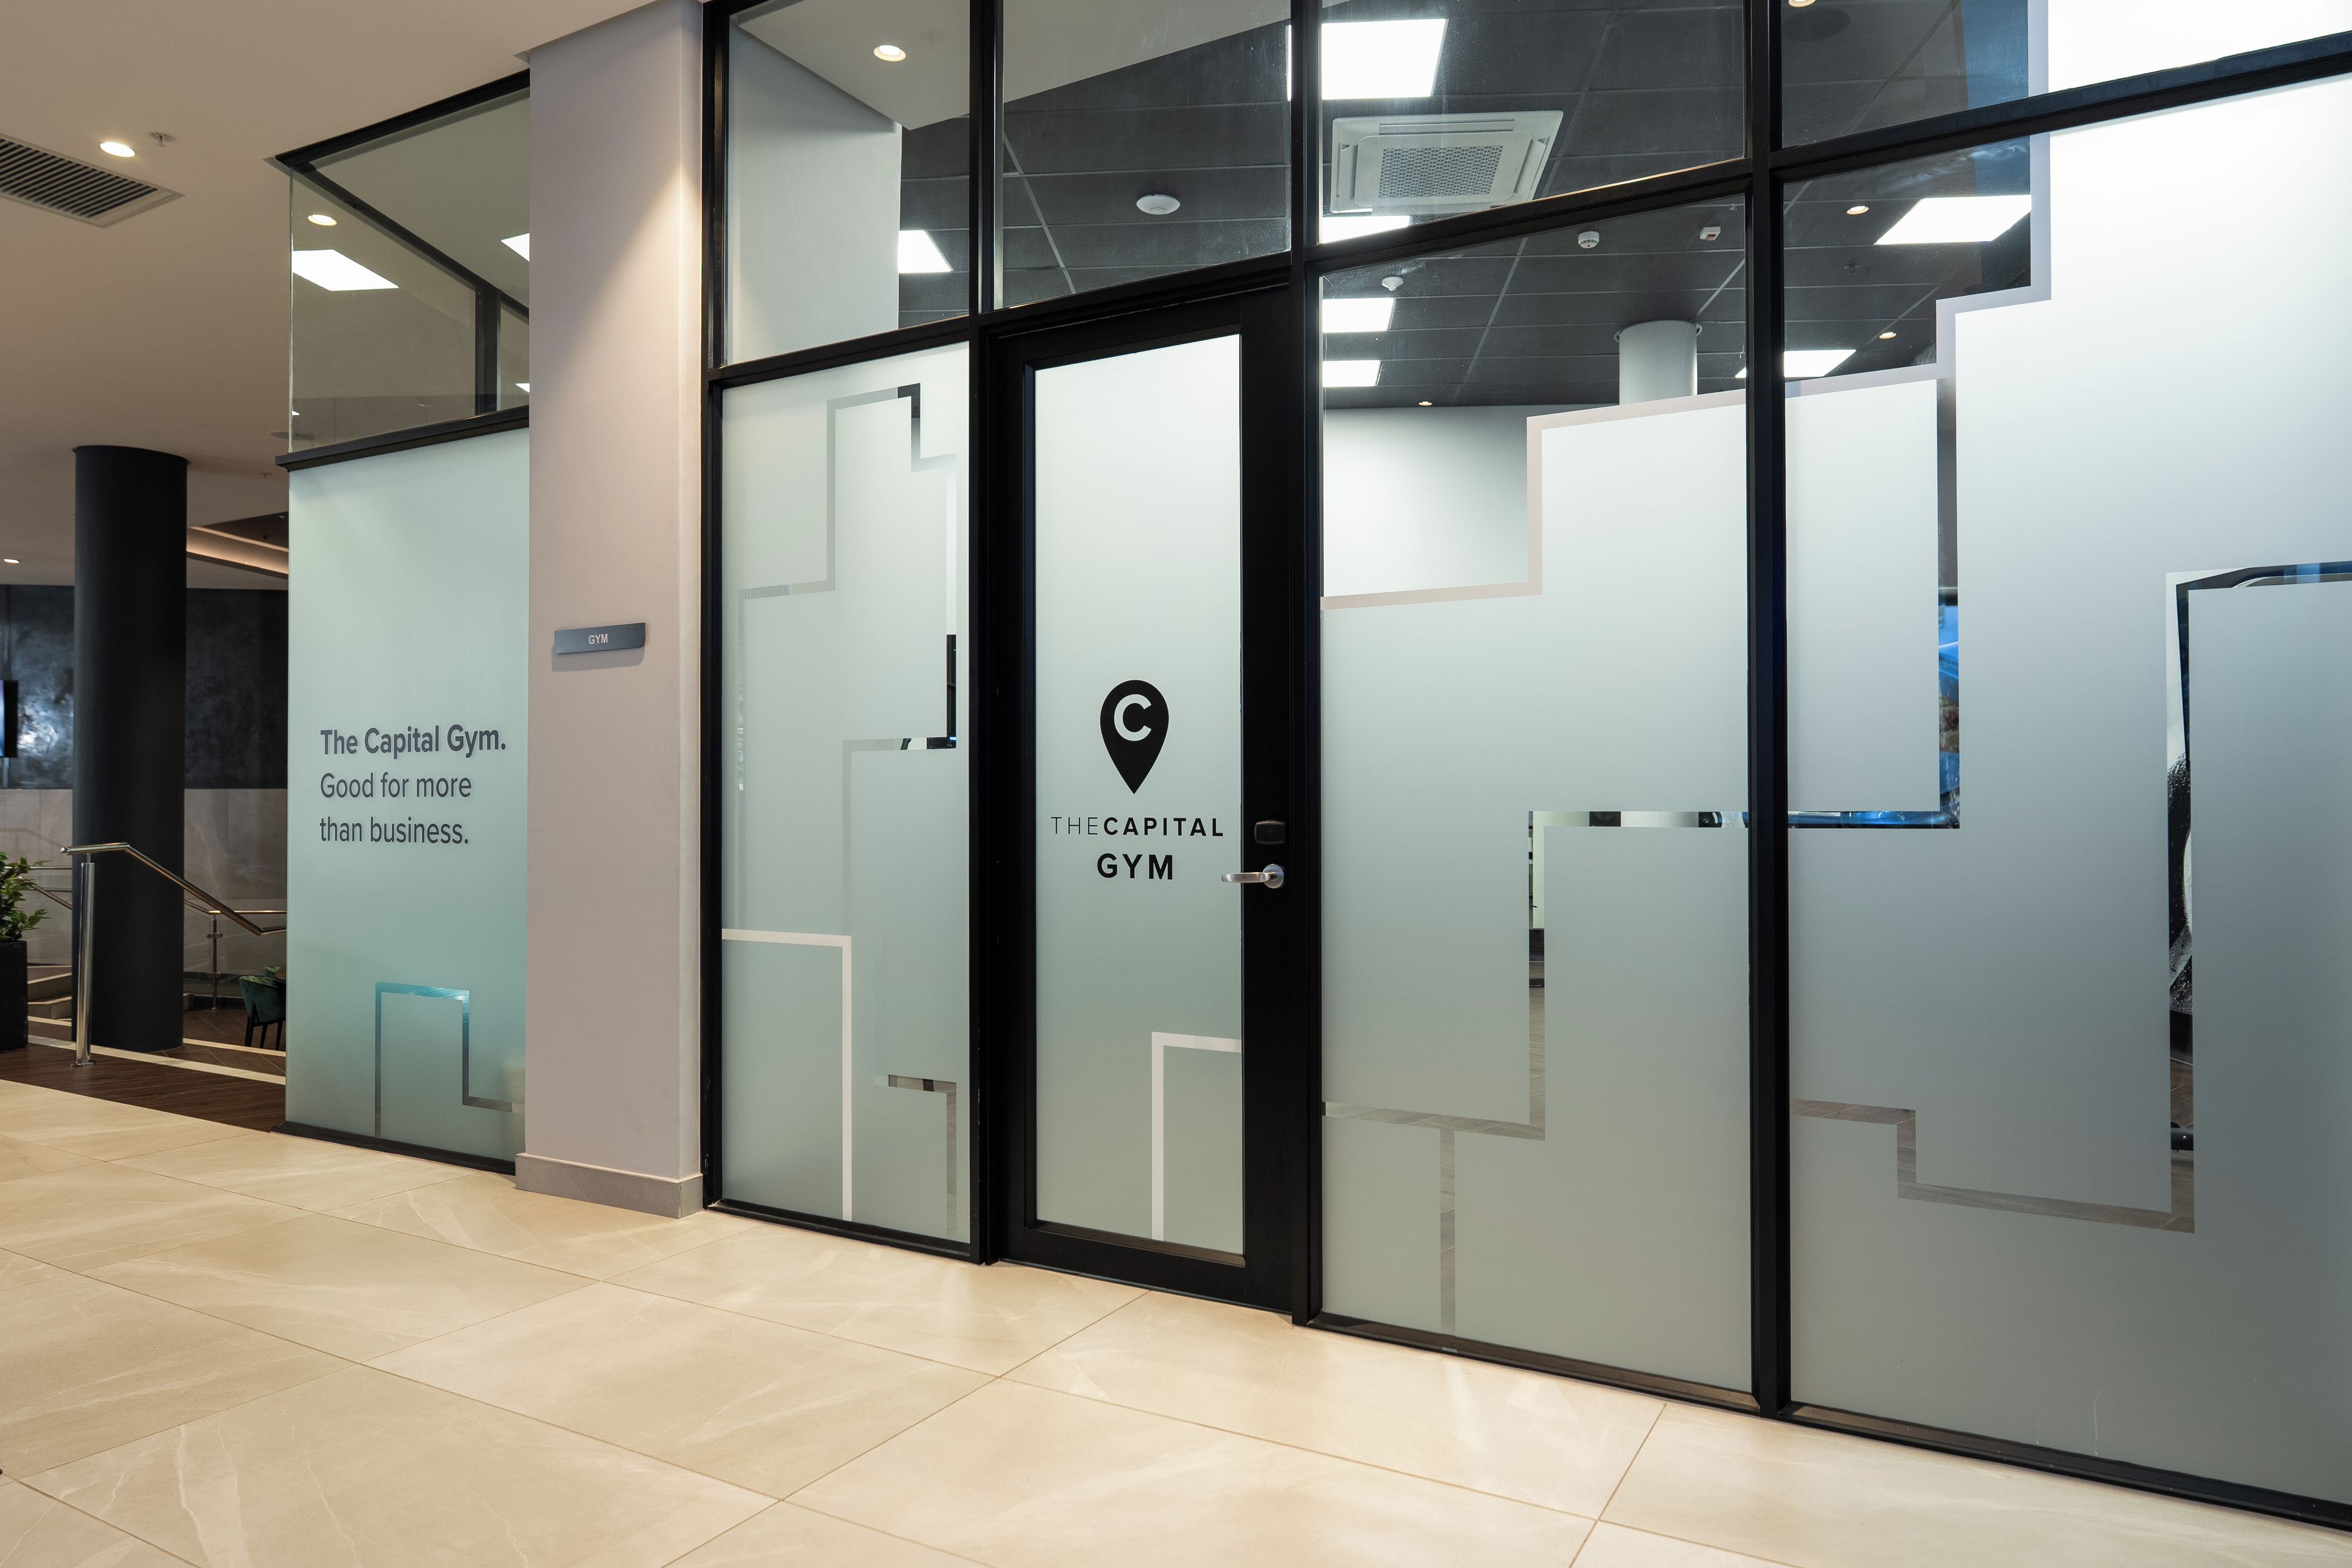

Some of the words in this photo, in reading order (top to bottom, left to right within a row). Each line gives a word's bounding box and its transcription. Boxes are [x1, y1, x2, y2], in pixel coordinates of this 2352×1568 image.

[588, 633, 608, 645] GYM
[1114, 694, 1152, 742] C
[320, 729, 358, 755] The
[364, 725, 439, 760] Capital
[447, 724, 506, 758] Gym.
[320, 772, 374, 798] Good
[380, 772, 409, 798] for
[417, 777, 472, 797] more
[319, 816, 363, 842] than
[371, 816, 469, 845] business.
[1097, 853, 1173, 880] GYM
